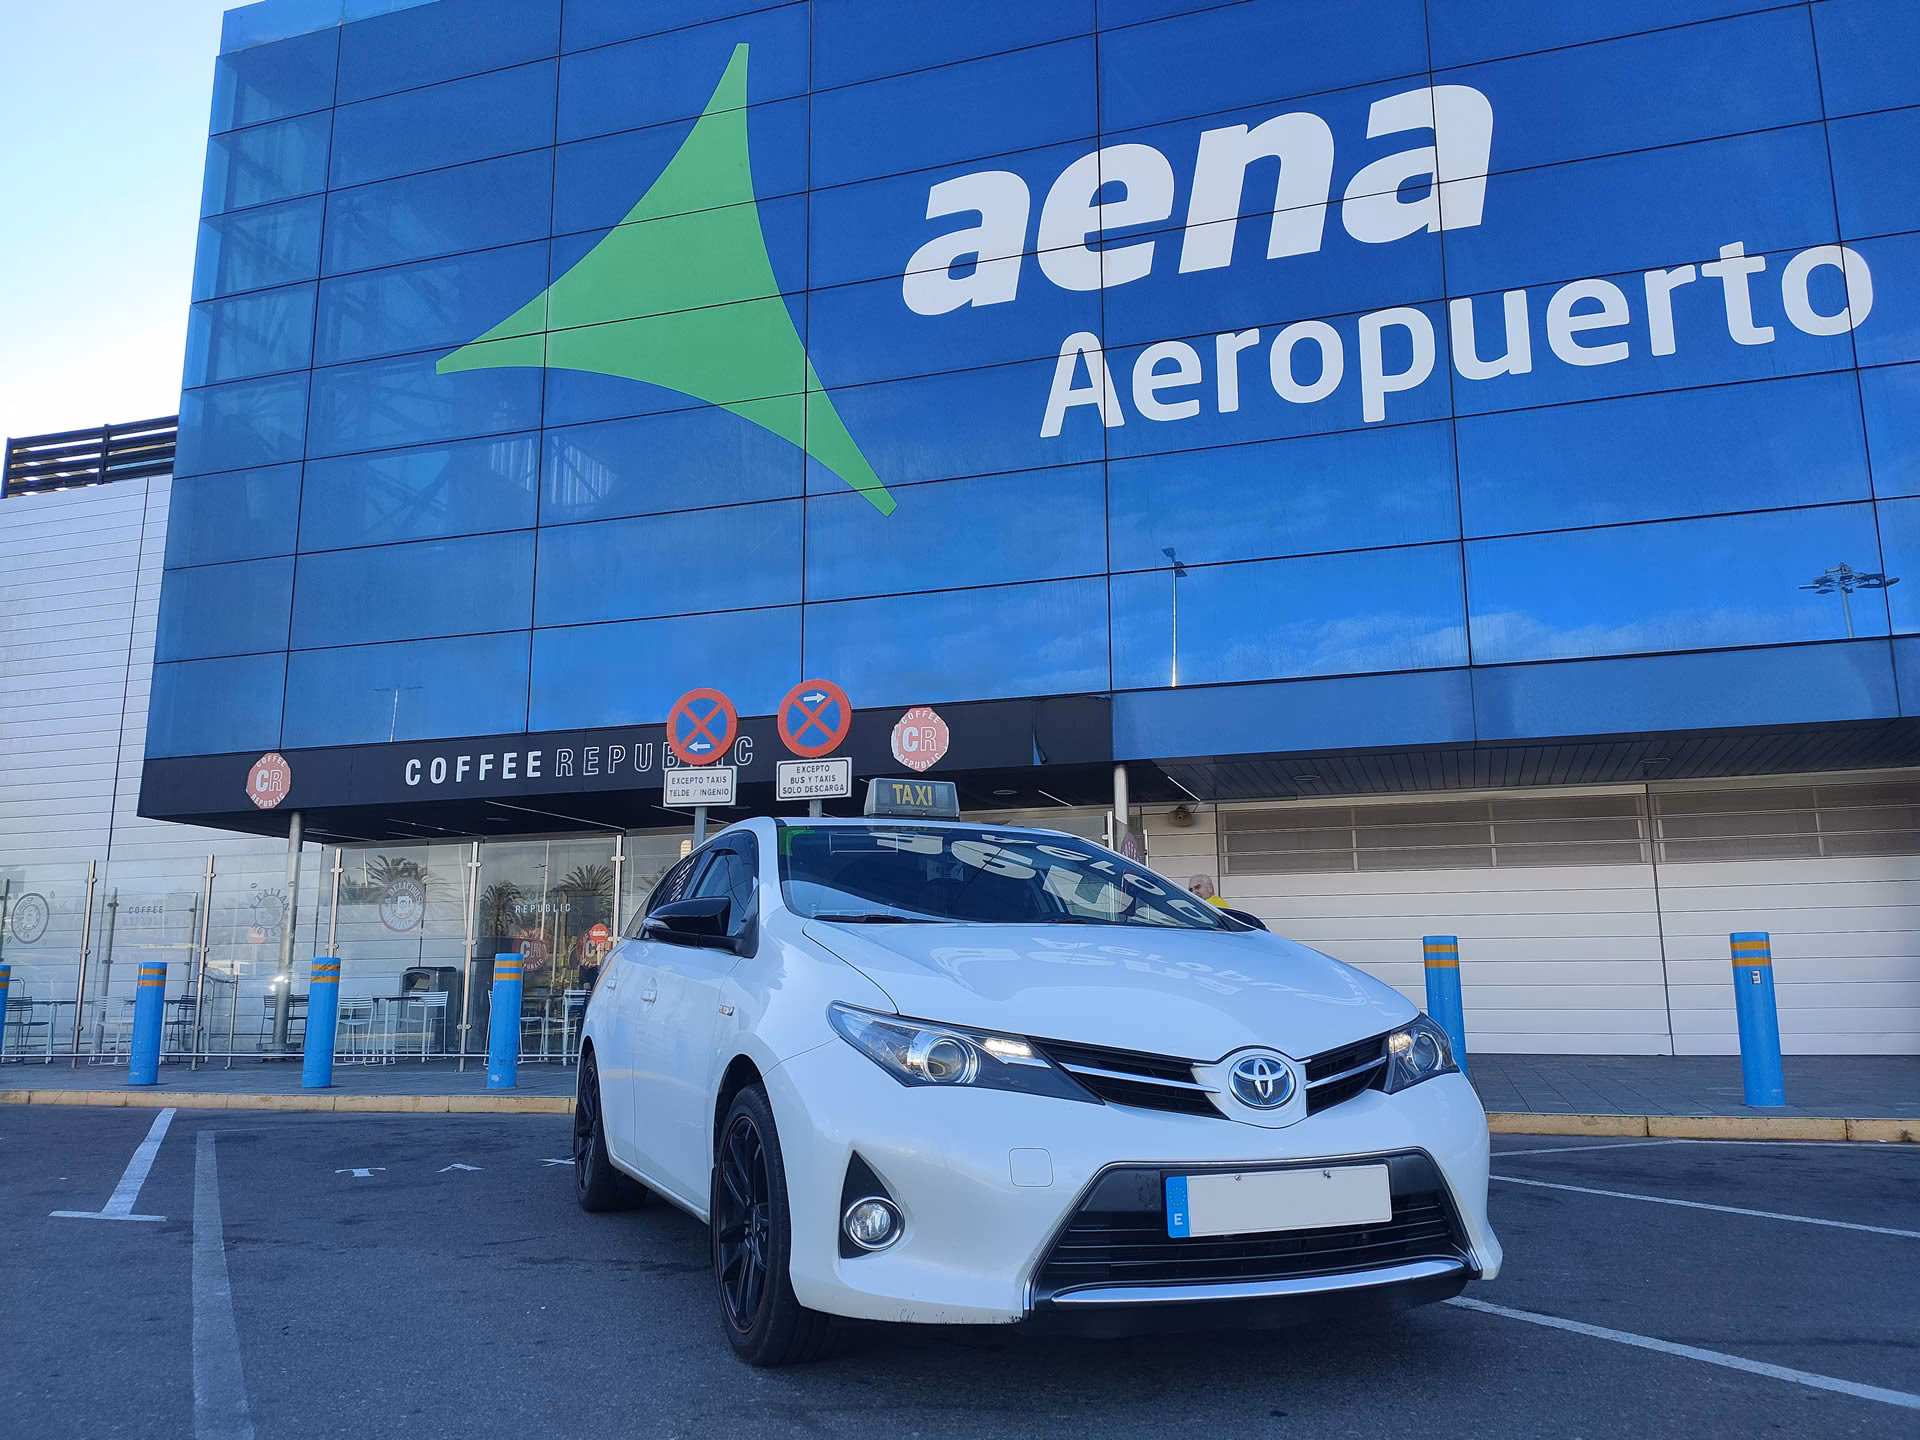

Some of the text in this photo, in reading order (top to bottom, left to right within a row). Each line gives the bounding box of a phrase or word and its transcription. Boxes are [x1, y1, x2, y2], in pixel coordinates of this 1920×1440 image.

[903, 85, 1494, 315] aena
[1040, 242, 1874, 438] Aeropuerto
[900, 710, 940, 725] COFFEE
[902, 726, 937, 752] CR
[256, 755, 287, 768] COFFEE
[405, 736, 754, 785] COFFEE REPUBC
[898, 752, 941, 769] REPUBLIC
[797, 764, 831, 774] EXCEPTO
[256, 769, 283, 792] CR
[671, 776, 727, 785] EXCEPTO TAXIS
[790, 776, 806, 784] BUS
[814, 774, 836, 782] TAXIS
[669, 789, 690, 797] TELDE
[699, 788, 729, 796] INGENIO
[782, 783, 844, 794] SOLO DESCARGA
[892, 783, 932, 806] TAXI
[250, 792, 286, 807] REPUBLIC
[388, 881, 422, 903] DELICIOUS
[128, 905, 164, 915] COFFEE
[515, 904, 571, 913] REPUBLIC
[520, 940, 541, 958] CR
[1173, 1213, 1183, 1225] E
